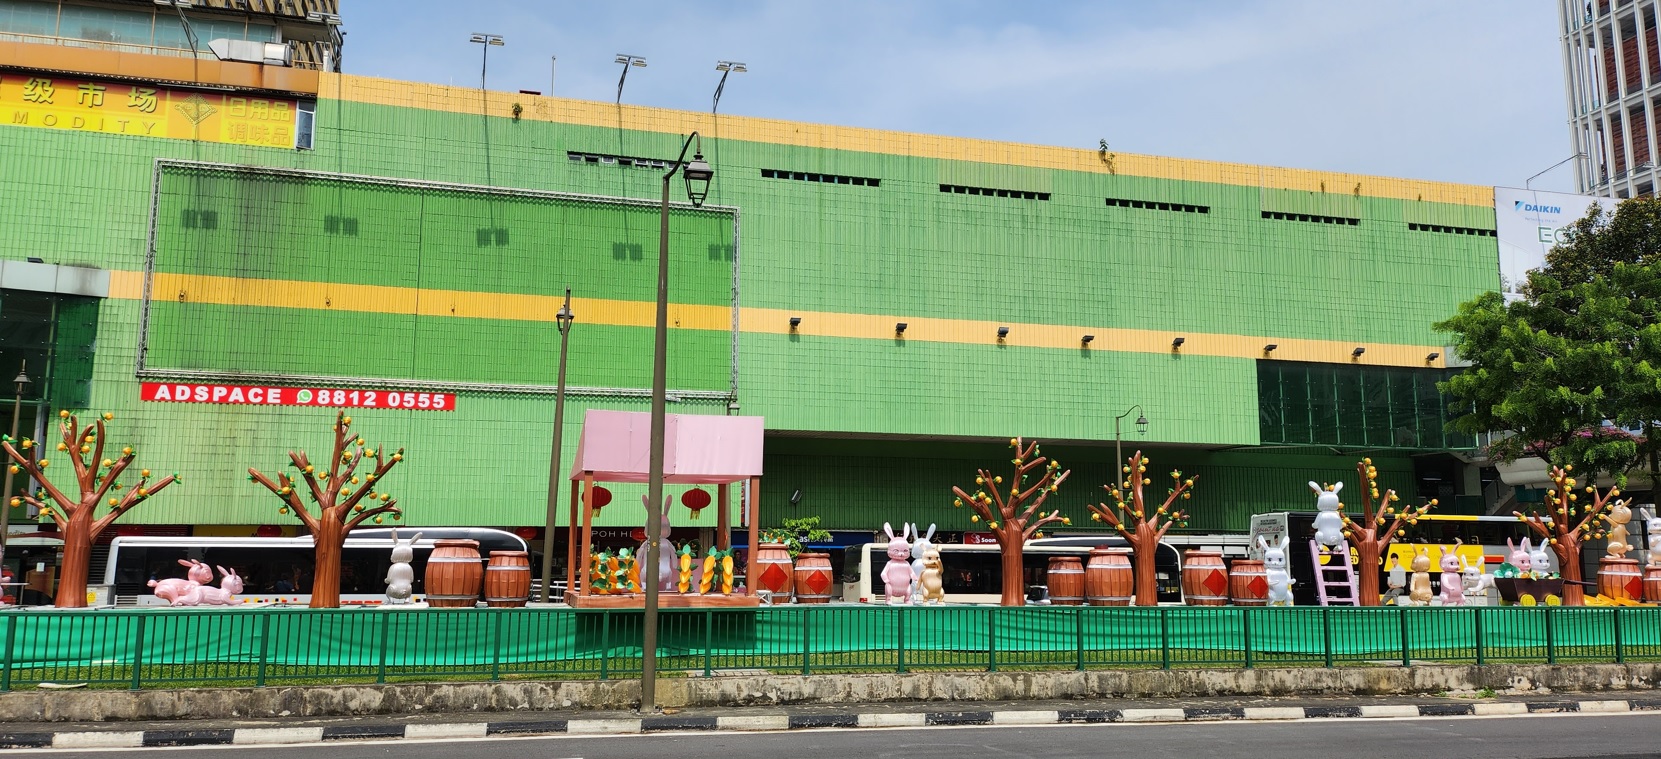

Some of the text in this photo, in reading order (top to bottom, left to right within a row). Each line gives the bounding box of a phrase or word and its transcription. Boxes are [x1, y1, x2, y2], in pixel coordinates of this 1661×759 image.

[0, 76, 158, 113] 级市场
[230, 97, 291, 122] 日用品
[228, 121, 291, 146] 调味品
[1525, 204, 1560, 214] DAIKIN
[154, 385, 445, 408] ADSPACE 8812 0555
